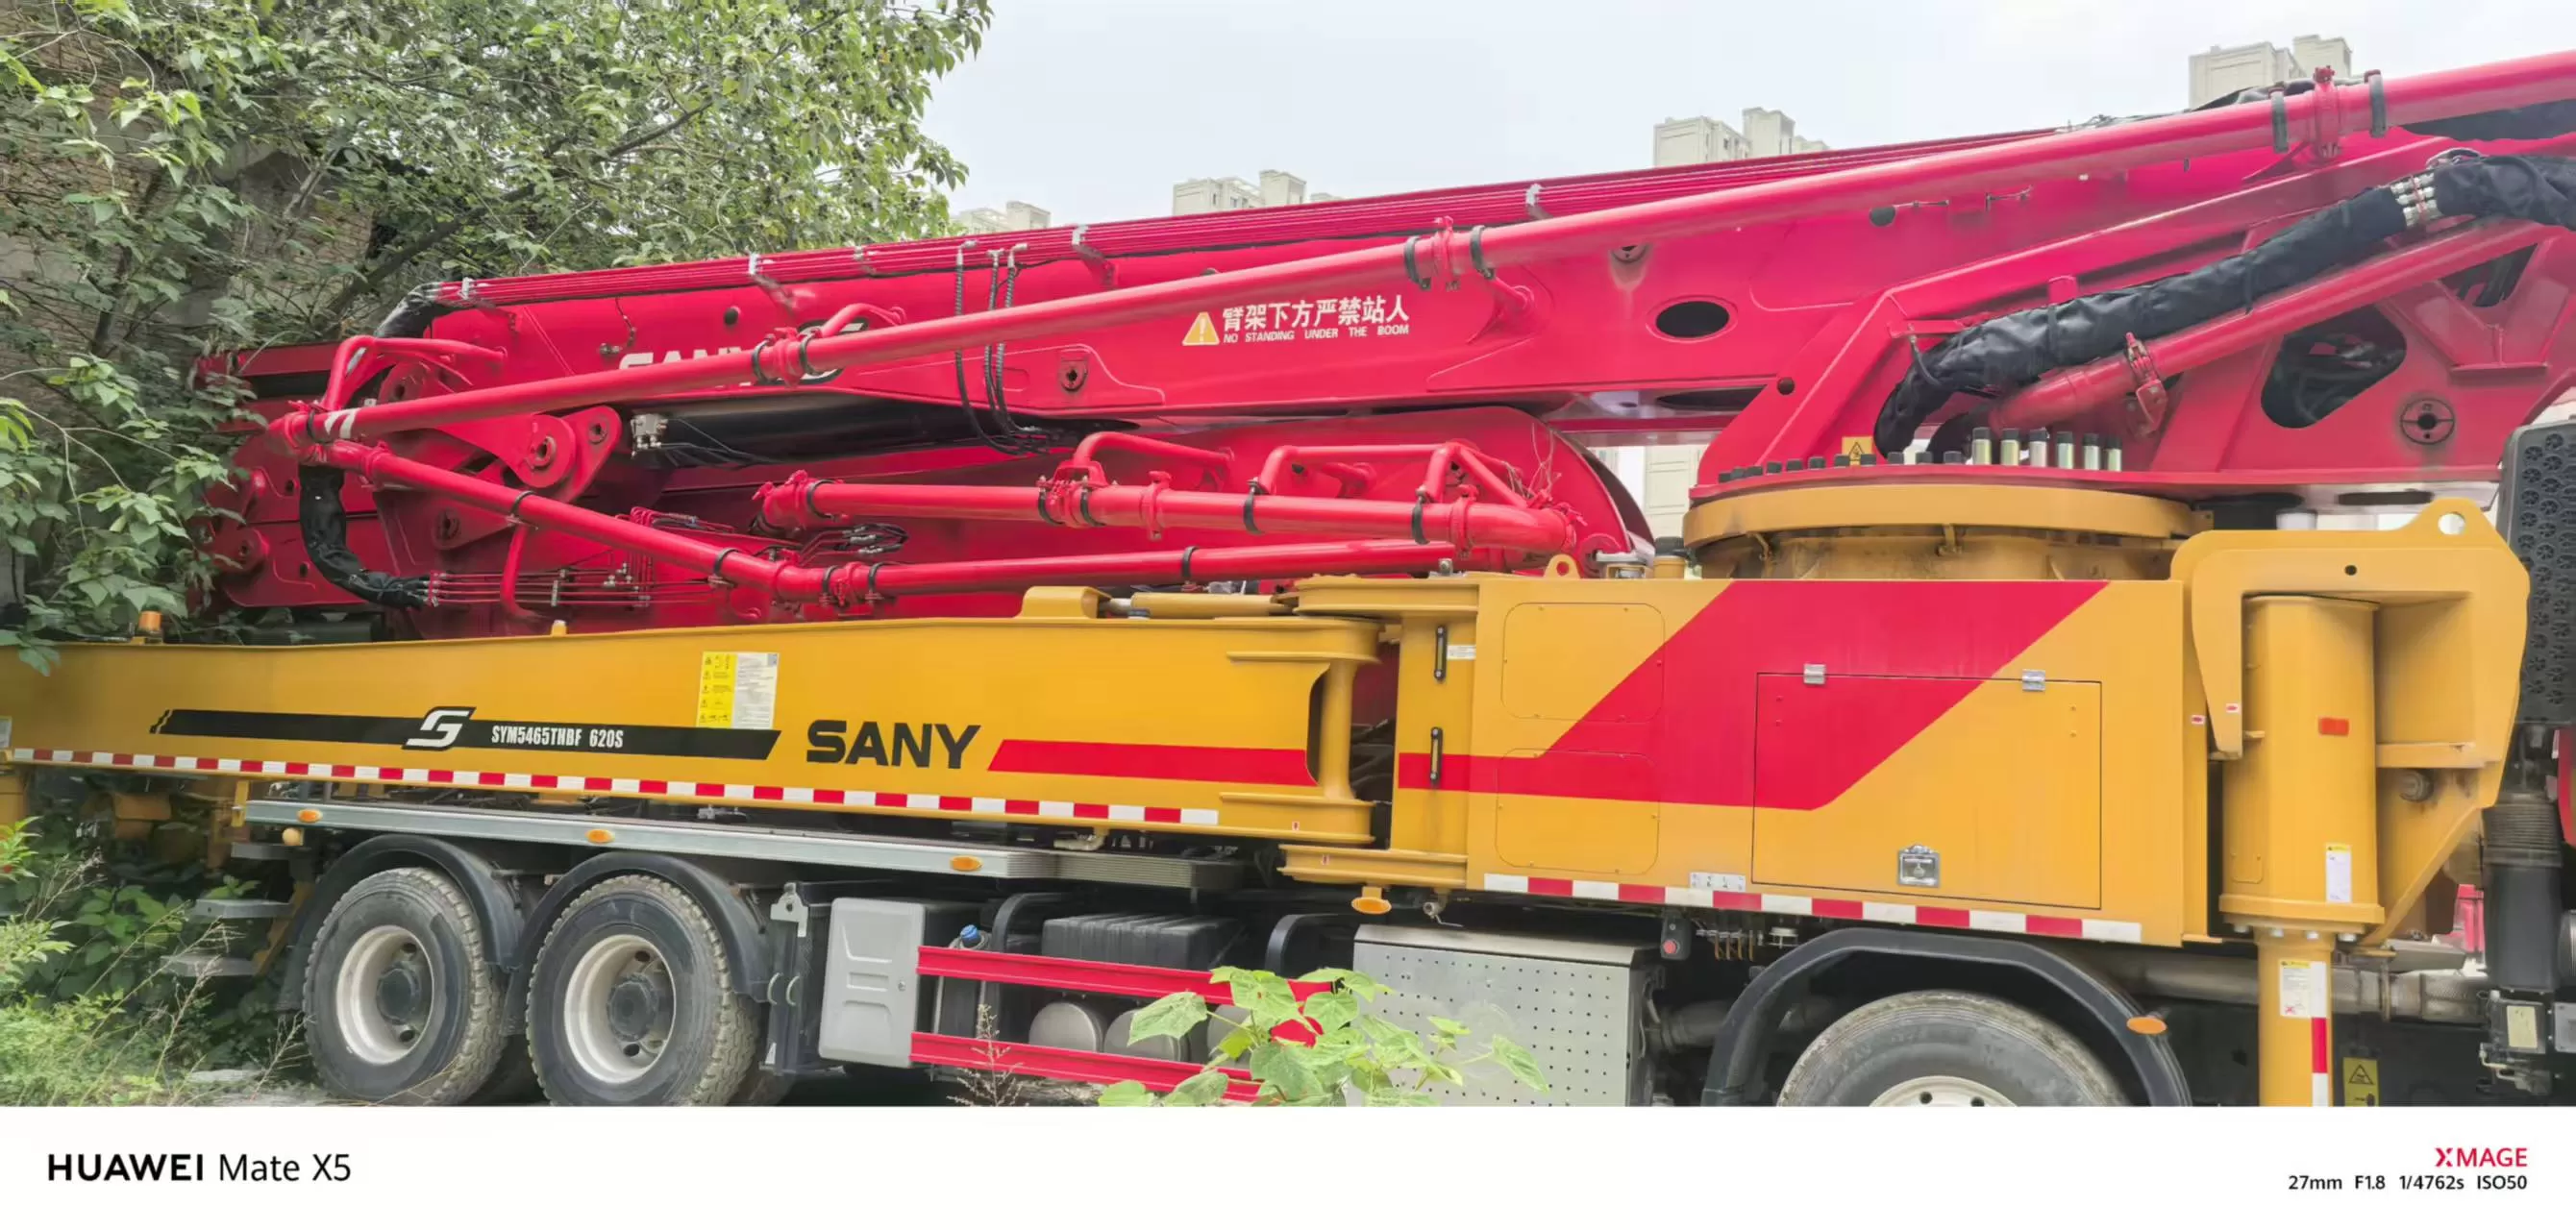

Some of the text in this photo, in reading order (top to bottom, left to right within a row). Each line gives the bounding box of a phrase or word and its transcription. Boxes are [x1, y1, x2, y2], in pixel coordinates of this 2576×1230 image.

[1222, 294, 1409, 332] 臂架下方严禁站人
[1223, 324, 1409, 344] NO STANDING UNDER THE BOOM
[491, 725, 624, 749] SYM5465THBF 620S
[806, 719, 981, 770] SANY
